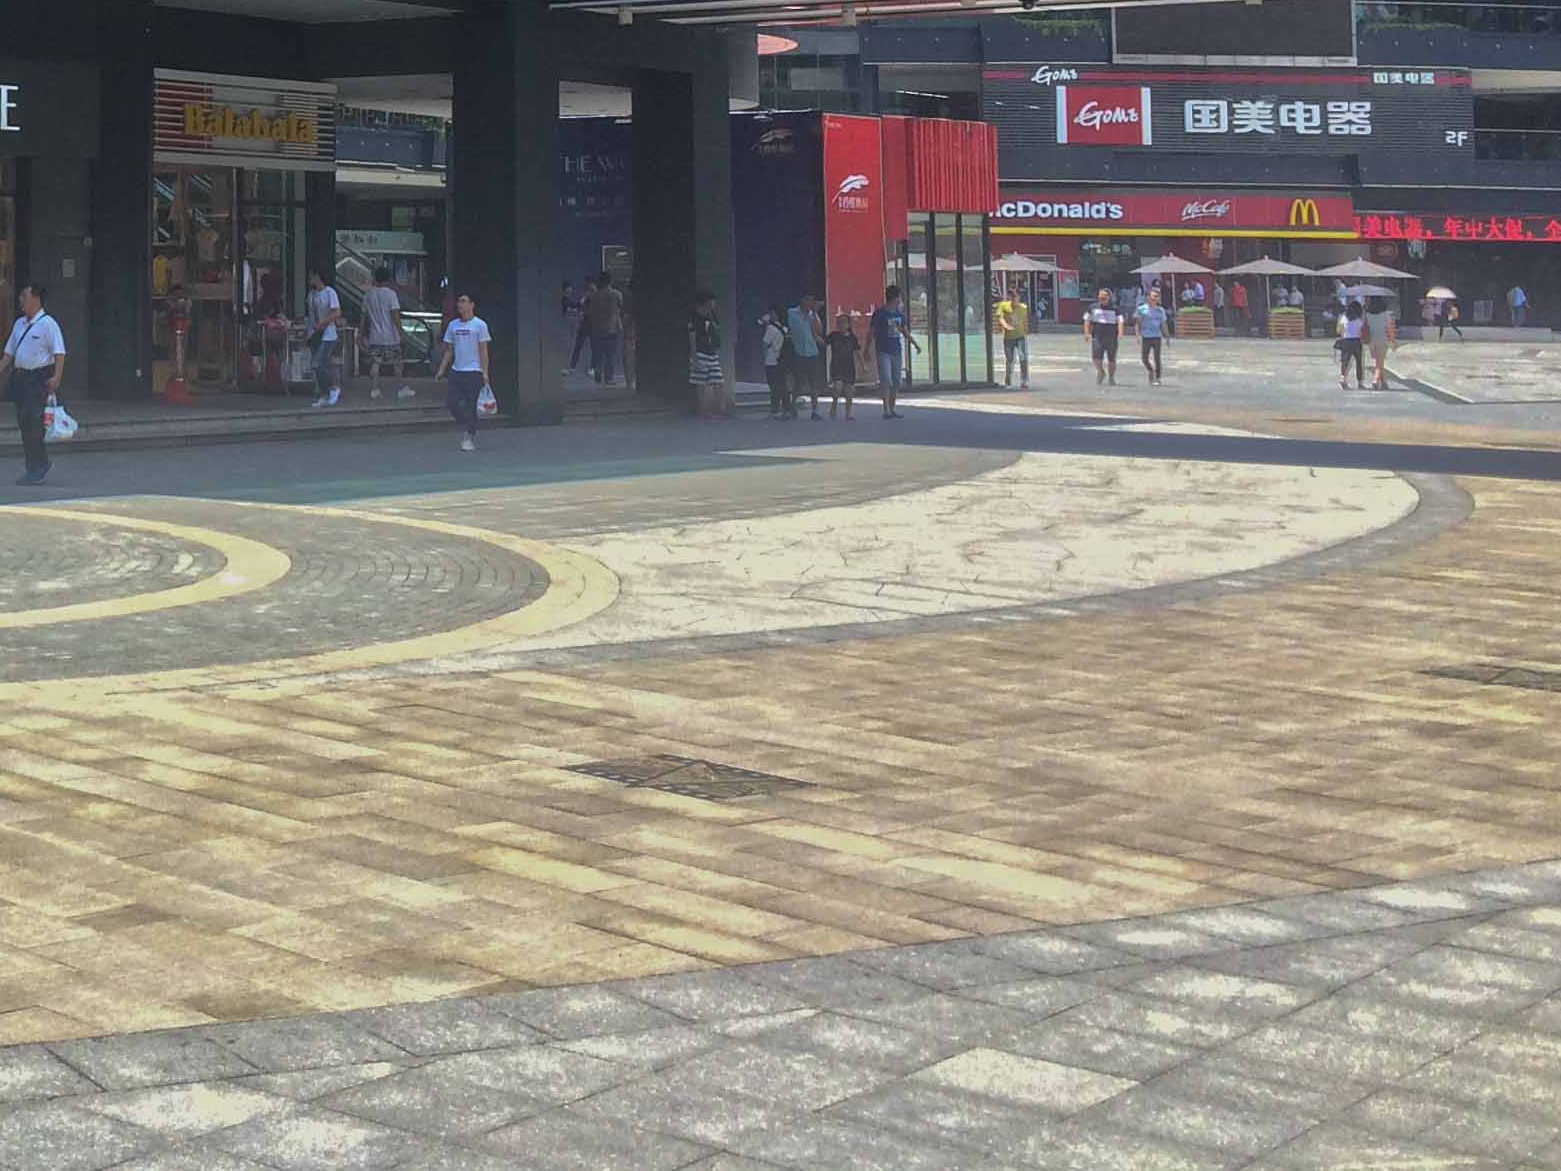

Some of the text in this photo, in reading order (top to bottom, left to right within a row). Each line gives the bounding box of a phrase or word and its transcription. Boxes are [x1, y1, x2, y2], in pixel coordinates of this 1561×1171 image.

[1372, 72, 1436, 85] 国美电器
[1183, 99, 1372, 135] 国美电器
[1444, 131, 1469, 147] 2F
